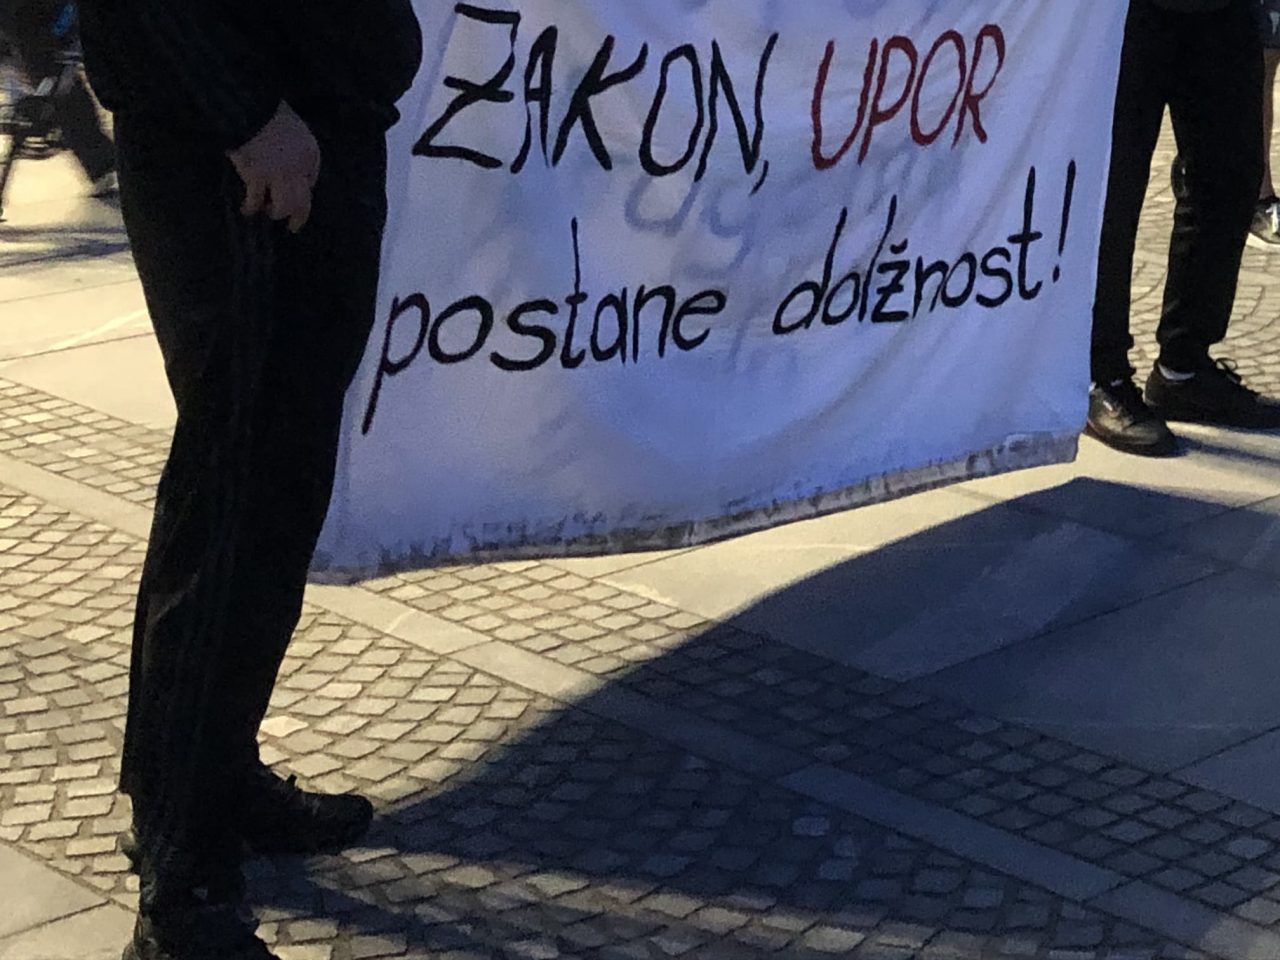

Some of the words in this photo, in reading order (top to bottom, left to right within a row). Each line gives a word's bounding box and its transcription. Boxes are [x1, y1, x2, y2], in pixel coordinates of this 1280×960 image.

[809, 22, 1006, 170] UPOR
[361, 216, 728, 435] postane
[771, 158, 1077, 336] dolžnost!
